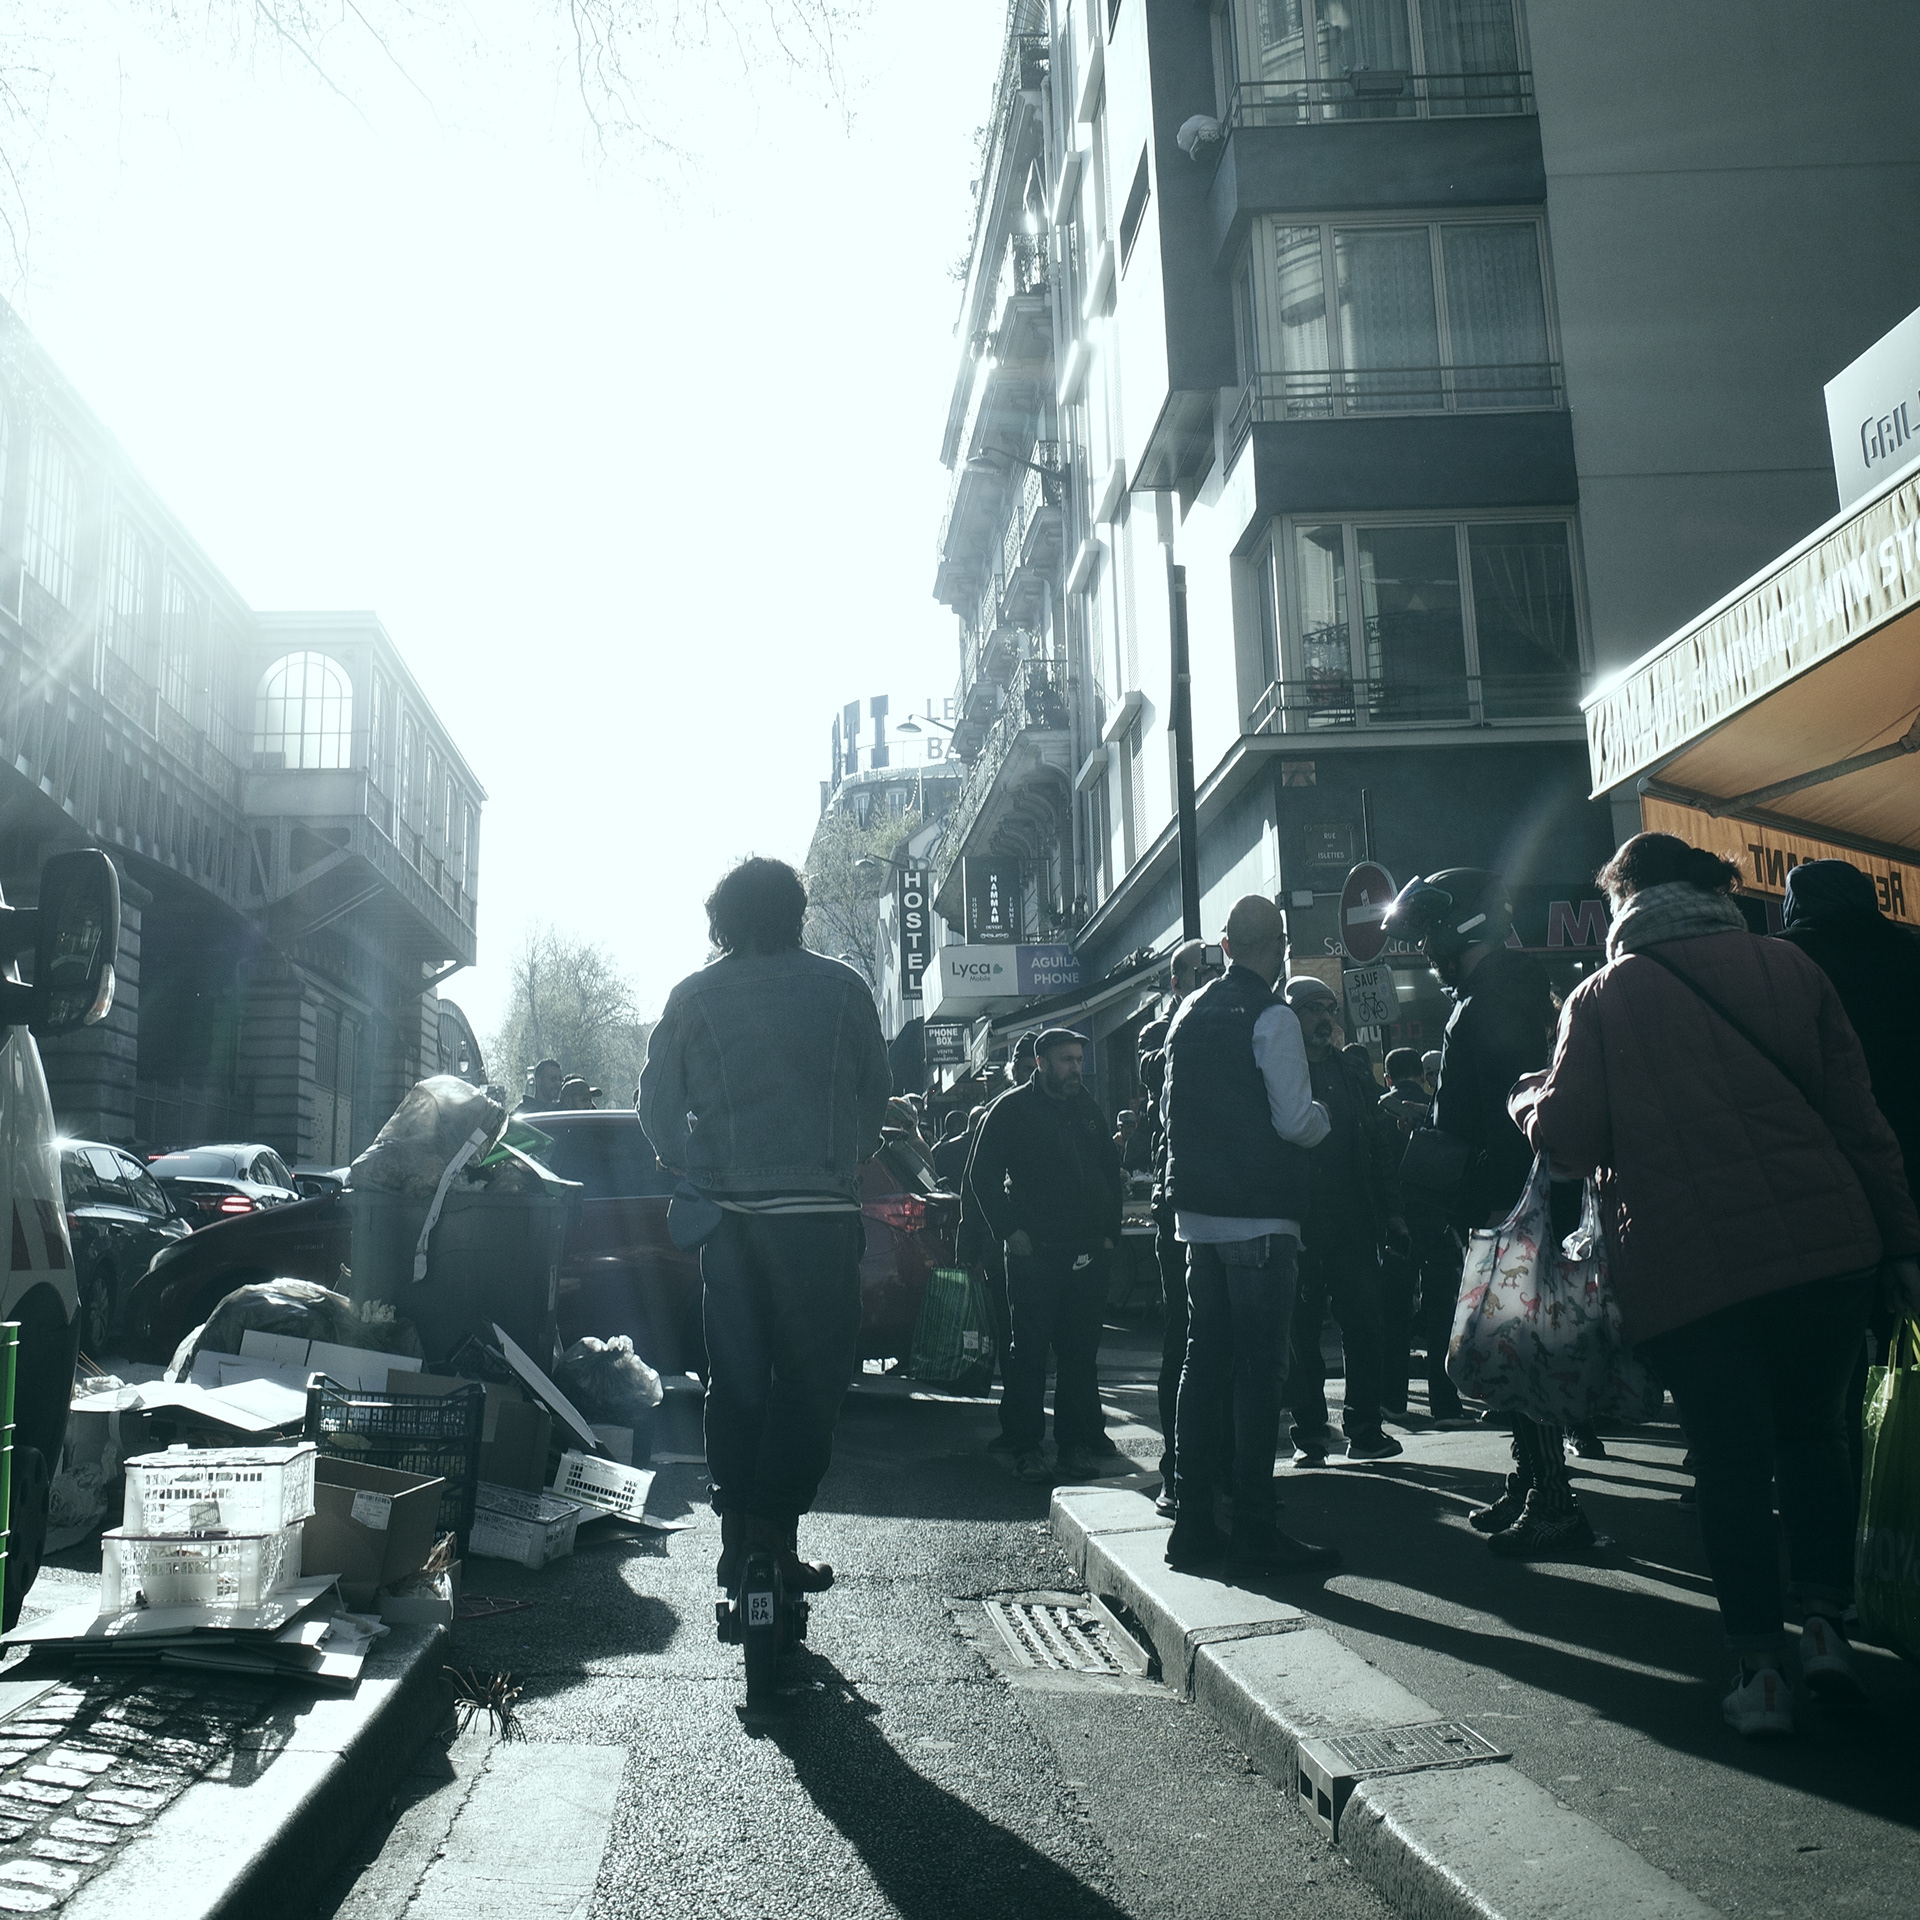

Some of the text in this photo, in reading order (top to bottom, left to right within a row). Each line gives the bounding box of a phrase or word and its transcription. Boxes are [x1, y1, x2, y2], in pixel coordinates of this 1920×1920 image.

[1860, 389, 1920, 469] GRIL
[1323, 832, 1337, 840] RUE
[990, 874, 999, 923] HAMMAM
[903, 871, 923, 990] HOSTEL
[1031, 956, 1080, 968] AGUILA
[952, 961, 990, 978] Lyca
[1034, 972, 1080, 984] PHONE
[1354, 972, 1378, 988] SAUF
[929, 1028, 958, 1037] PHONE
[936, 1037, 953, 1046] BOX
[752, 1597, 767, 1608] 55
